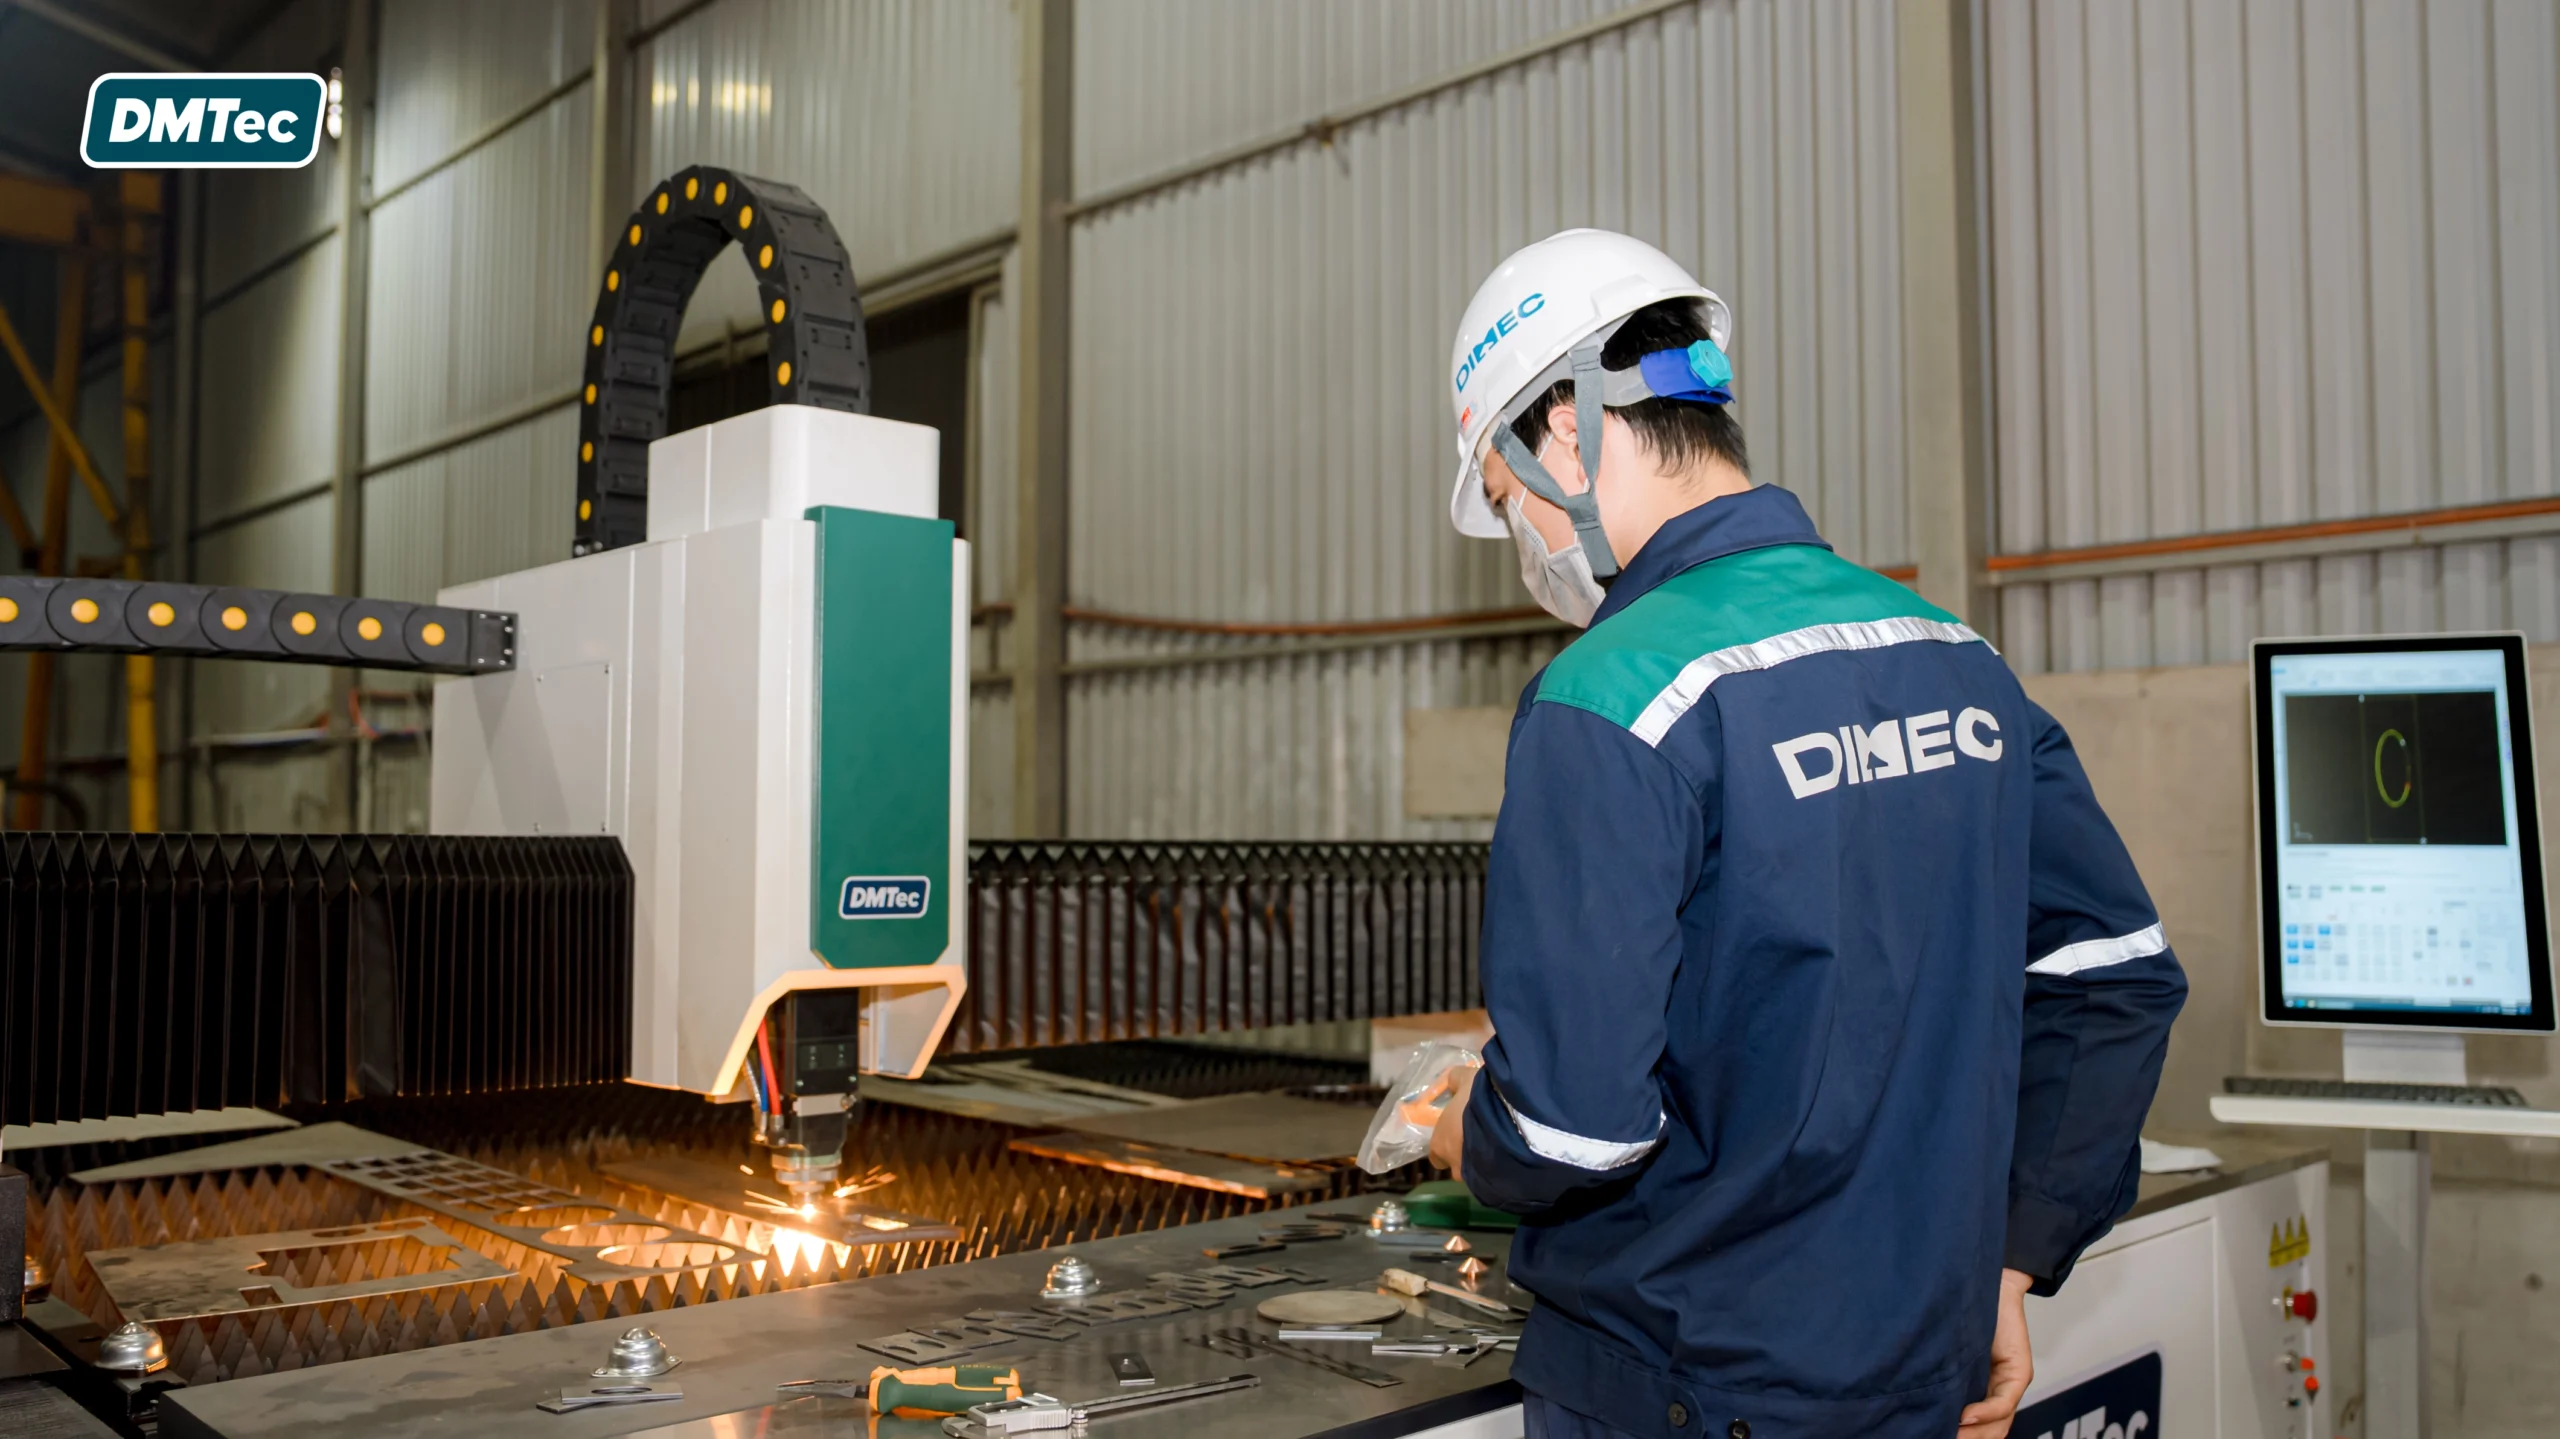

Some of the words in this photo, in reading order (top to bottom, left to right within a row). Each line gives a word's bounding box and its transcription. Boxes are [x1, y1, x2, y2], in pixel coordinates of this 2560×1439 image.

[1455, 292, 1545, 393] DIMEC
[1771, 706, 2003, 800] DIMEC
[849, 886, 921, 909] DMTec
